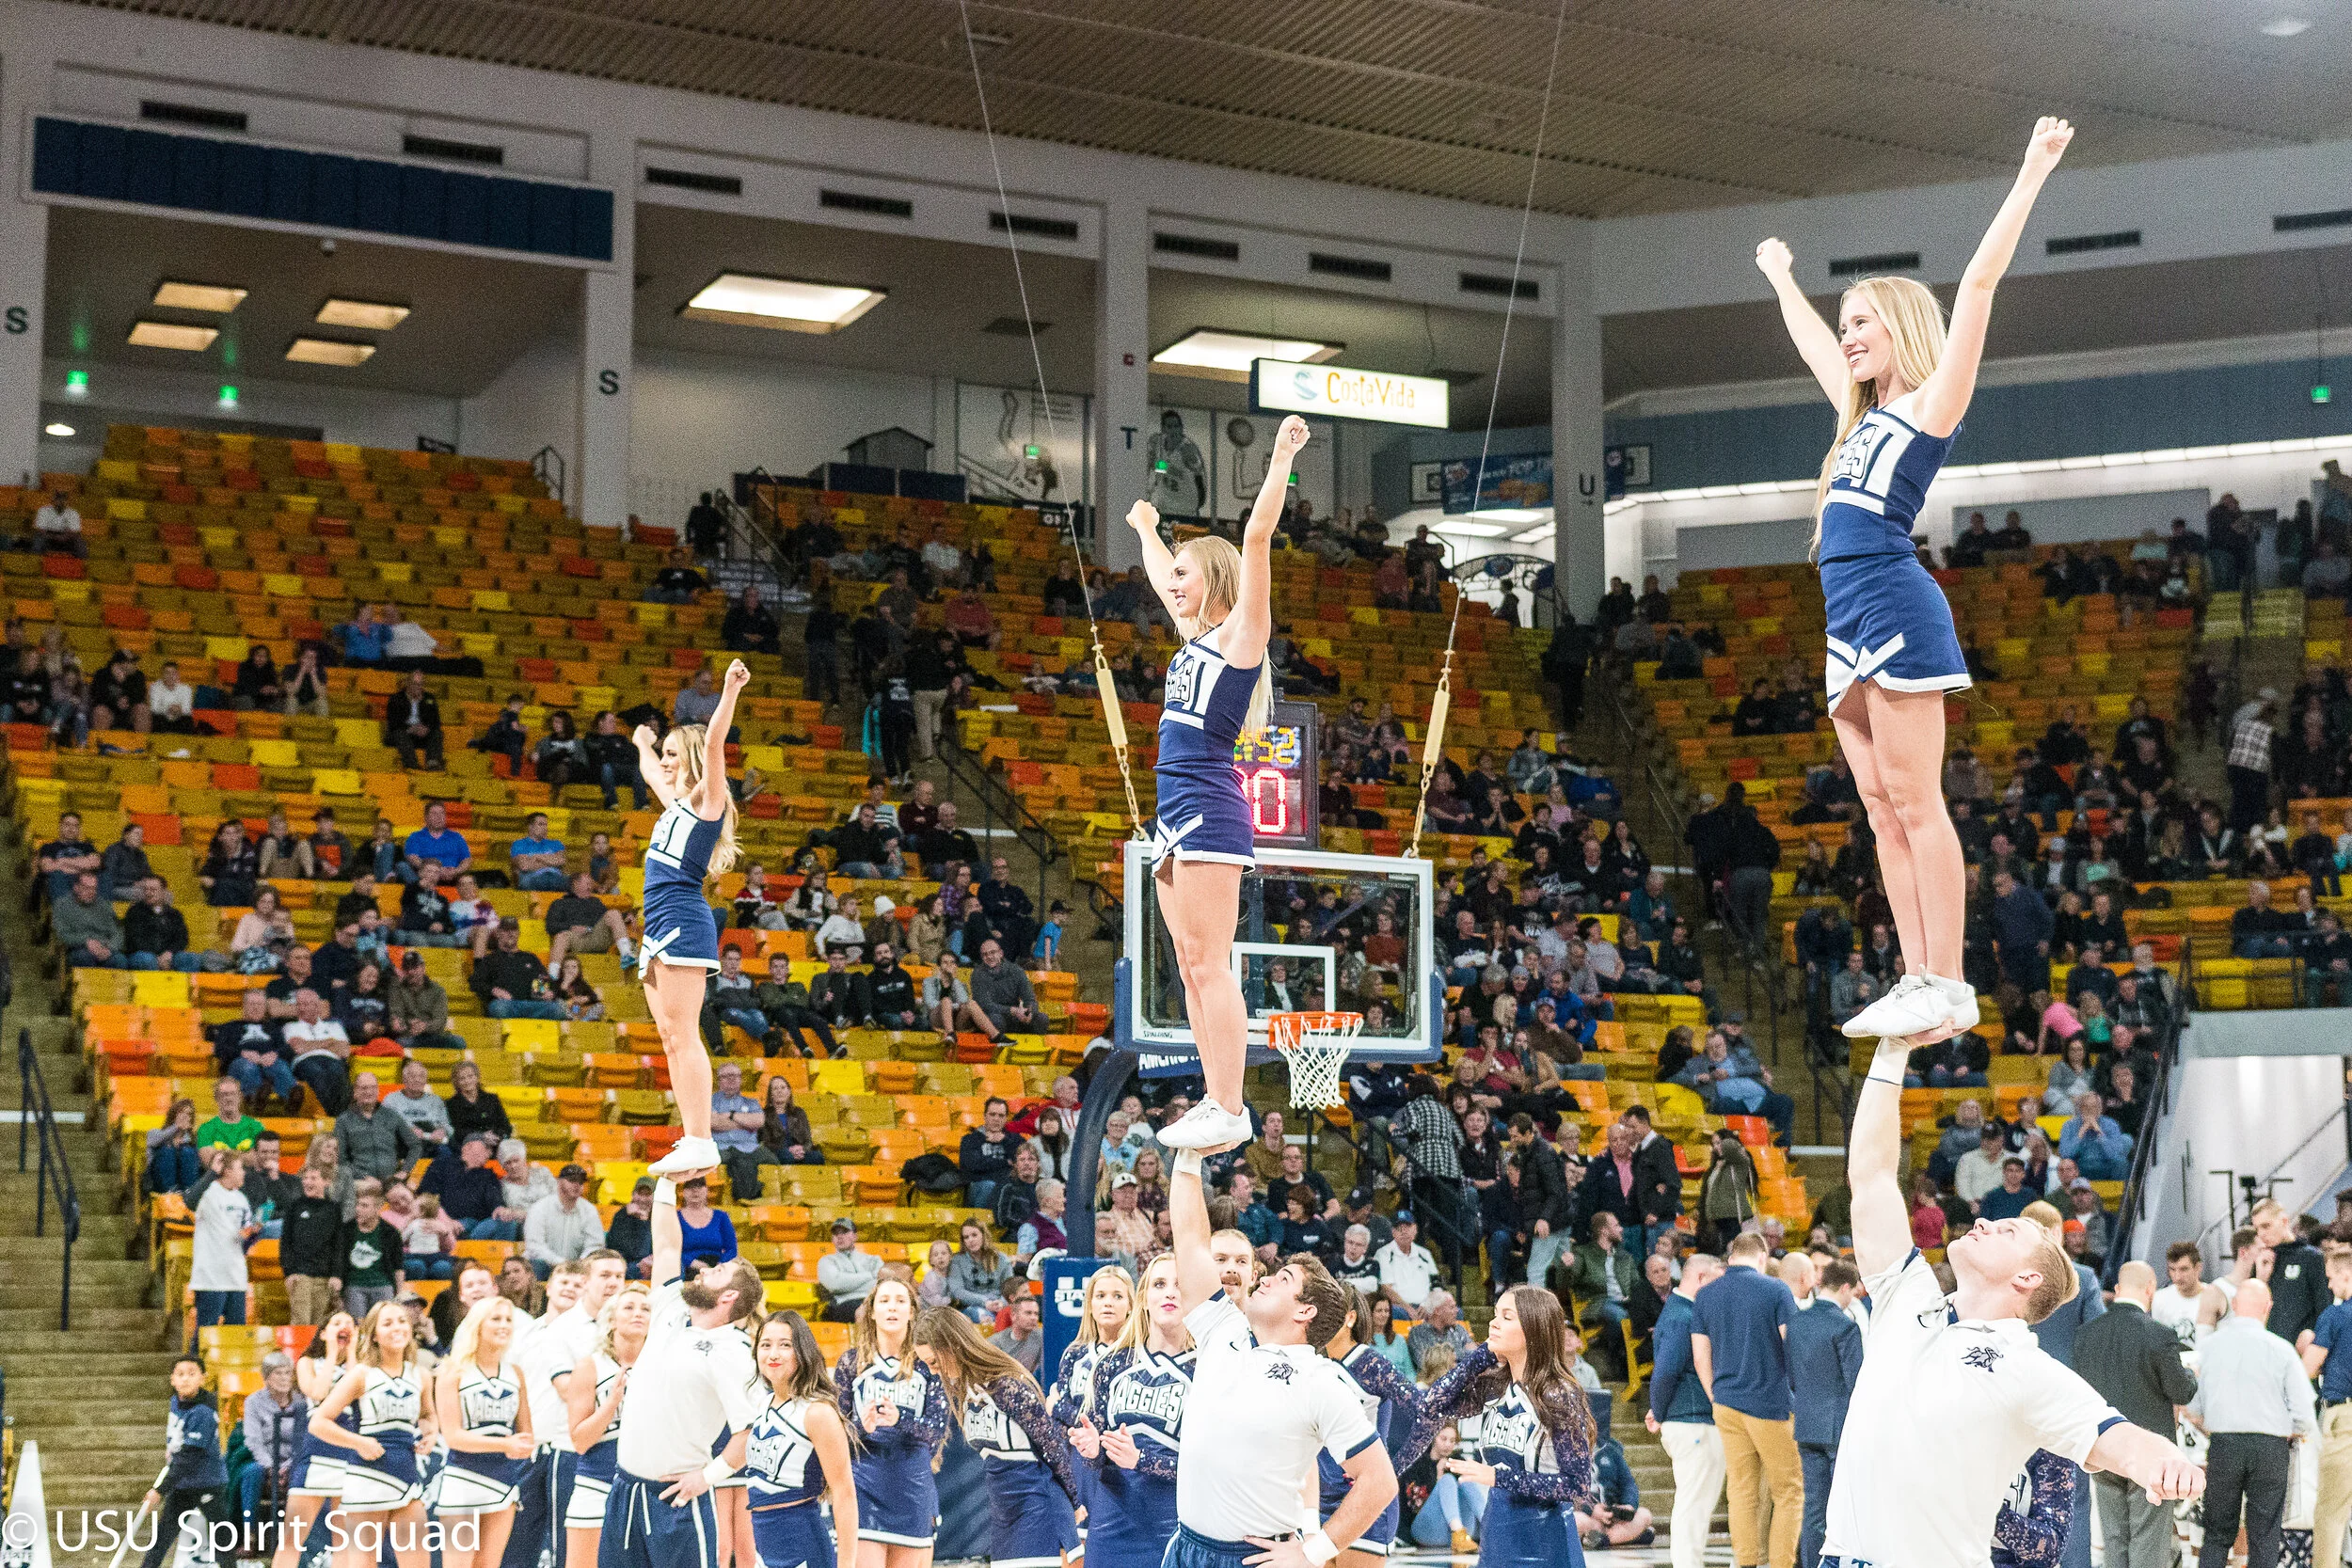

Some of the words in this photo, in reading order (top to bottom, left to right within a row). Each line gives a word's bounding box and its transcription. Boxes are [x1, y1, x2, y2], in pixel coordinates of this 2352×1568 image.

[6, 307, 27, 334] S
[599, 370, 619, 395] S
[1120, 425, 1137, 450] T
[1579, 472, 1596, 497] U
[1143, 1030, 1173, 1039] SPALDING
[864, 1376, 919, 1409] AGGIES
[1111, 1375, 1186, 1423] AGGIES
[1481, 1405, 1532, 1453] AGGIES
